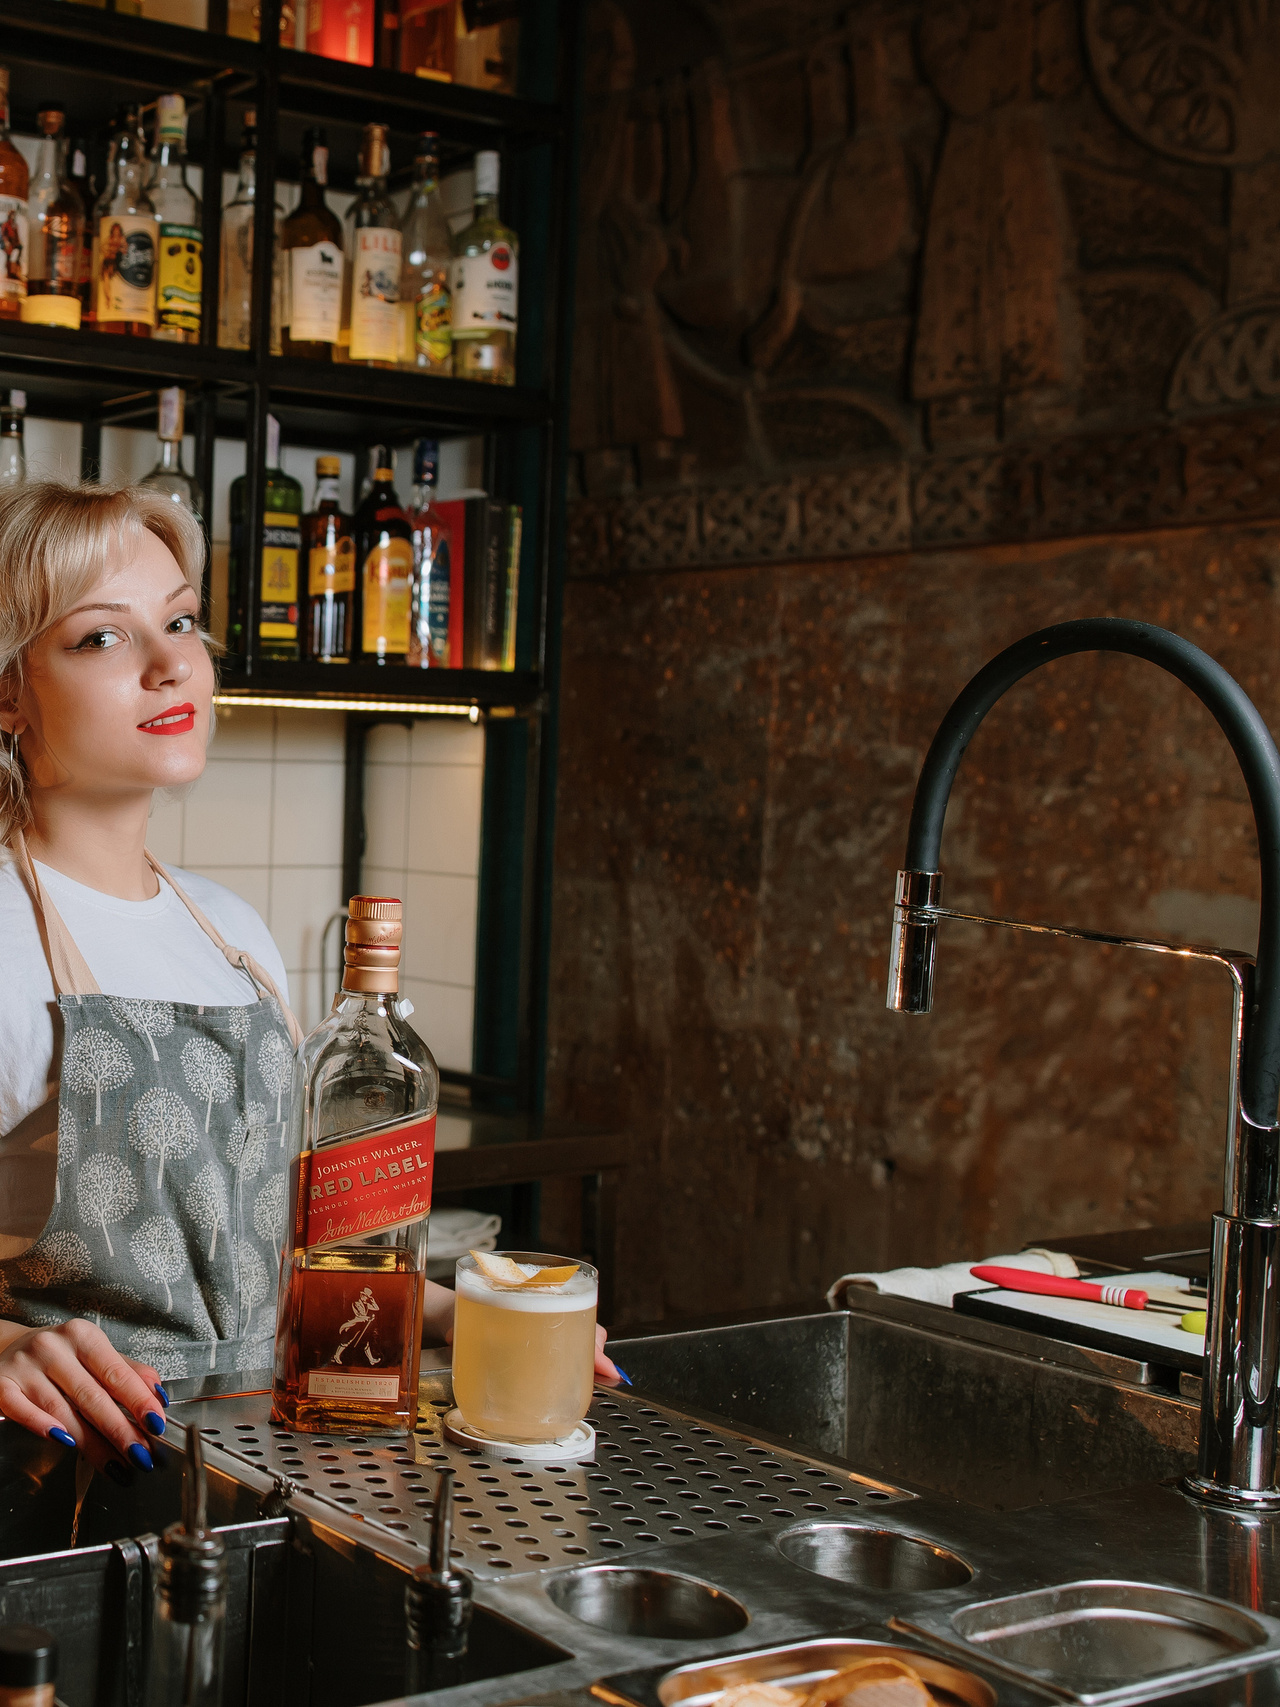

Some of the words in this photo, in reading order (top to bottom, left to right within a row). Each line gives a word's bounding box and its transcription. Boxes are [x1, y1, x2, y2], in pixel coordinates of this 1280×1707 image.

[308, 1176, 353, 1201] RED
[359, 1154, 428, 1187] LABEL
[317, 1155, 369, 1179] JOHNNIE
[370, 1140, 420, 1161] WALKER
[307, 1200, 349, 1216] BLENDED
[353, 1188, 389, 1203] SCOTCH
[392, 1175, 428, 1191] WHISKY
[317, 1217, 355, 1245] John
[354, 1205, 401, 1229] Walker
[315, 1377, 371, 1386] ESTABLISHED
